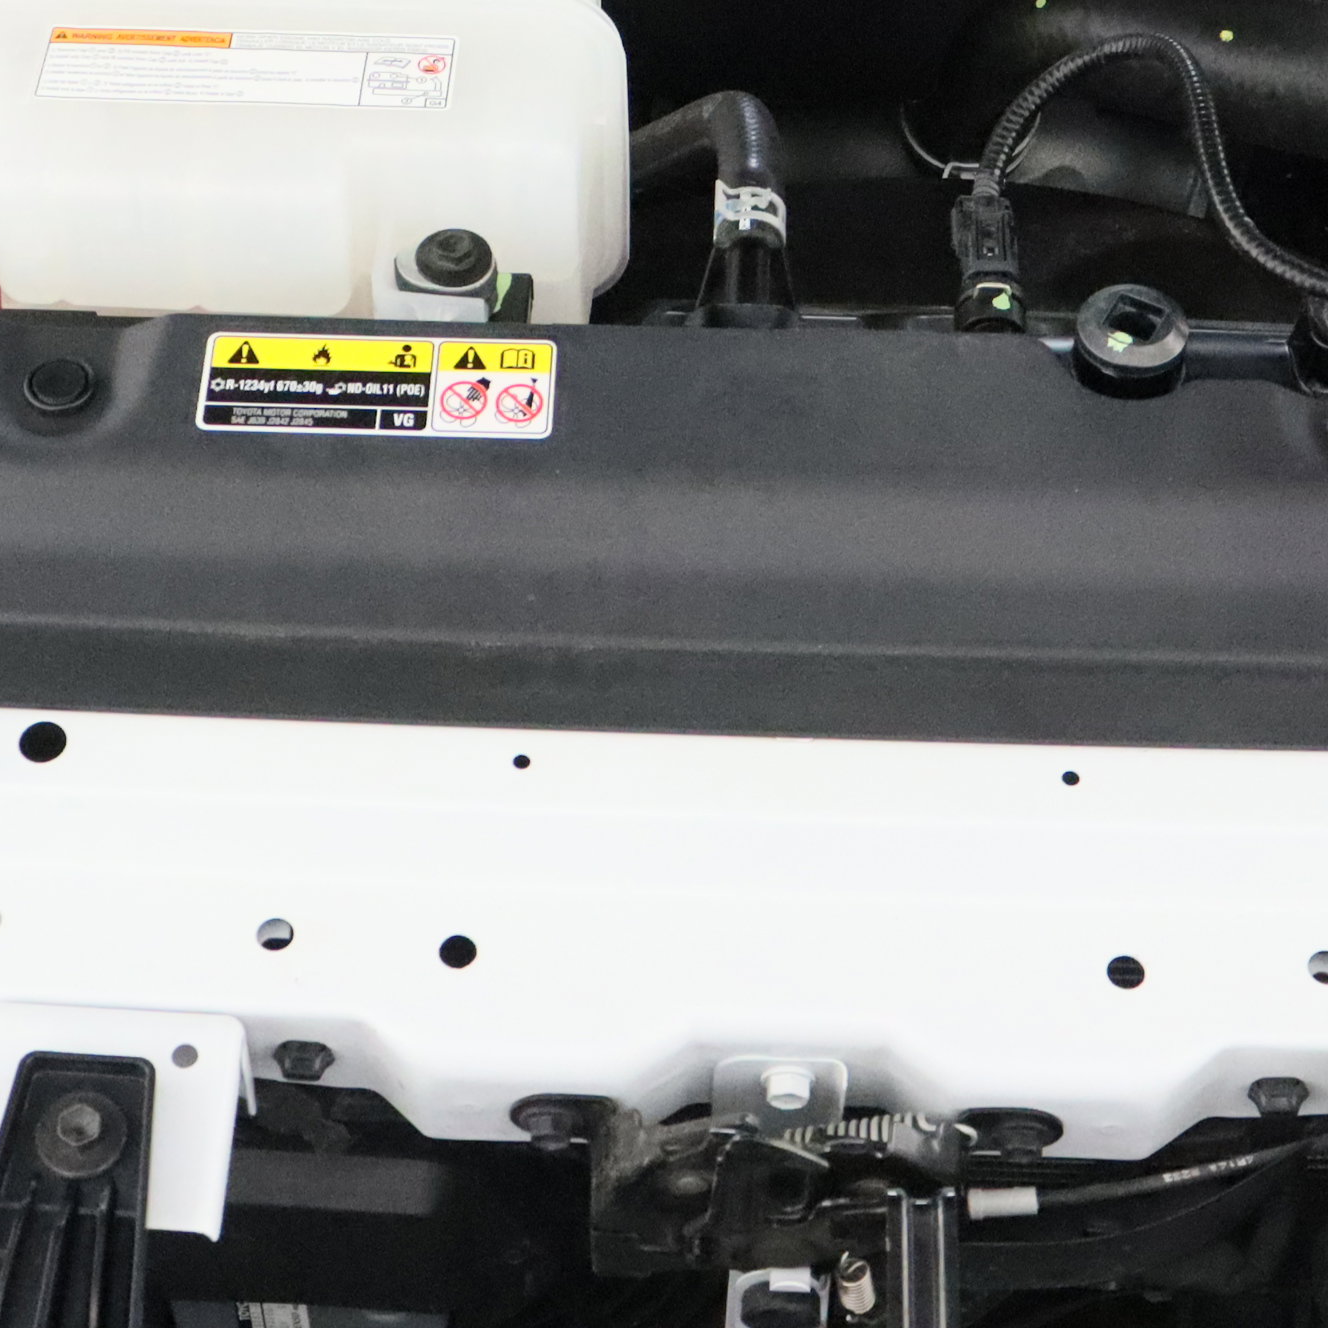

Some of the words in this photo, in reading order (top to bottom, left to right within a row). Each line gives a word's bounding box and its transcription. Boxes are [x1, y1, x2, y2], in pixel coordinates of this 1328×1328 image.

[71, 32, 113, 41] WARNING
[225, 378, 275, 394] R-1234yf
[396, 384, 425, 397] (POE)
[232, 407, 262, 415] TOYOTA
[263, 408, 291, 416] MOTOR
[293, 409, 348, 418] CORPORATION
[393, 413, 415, 427] VG
